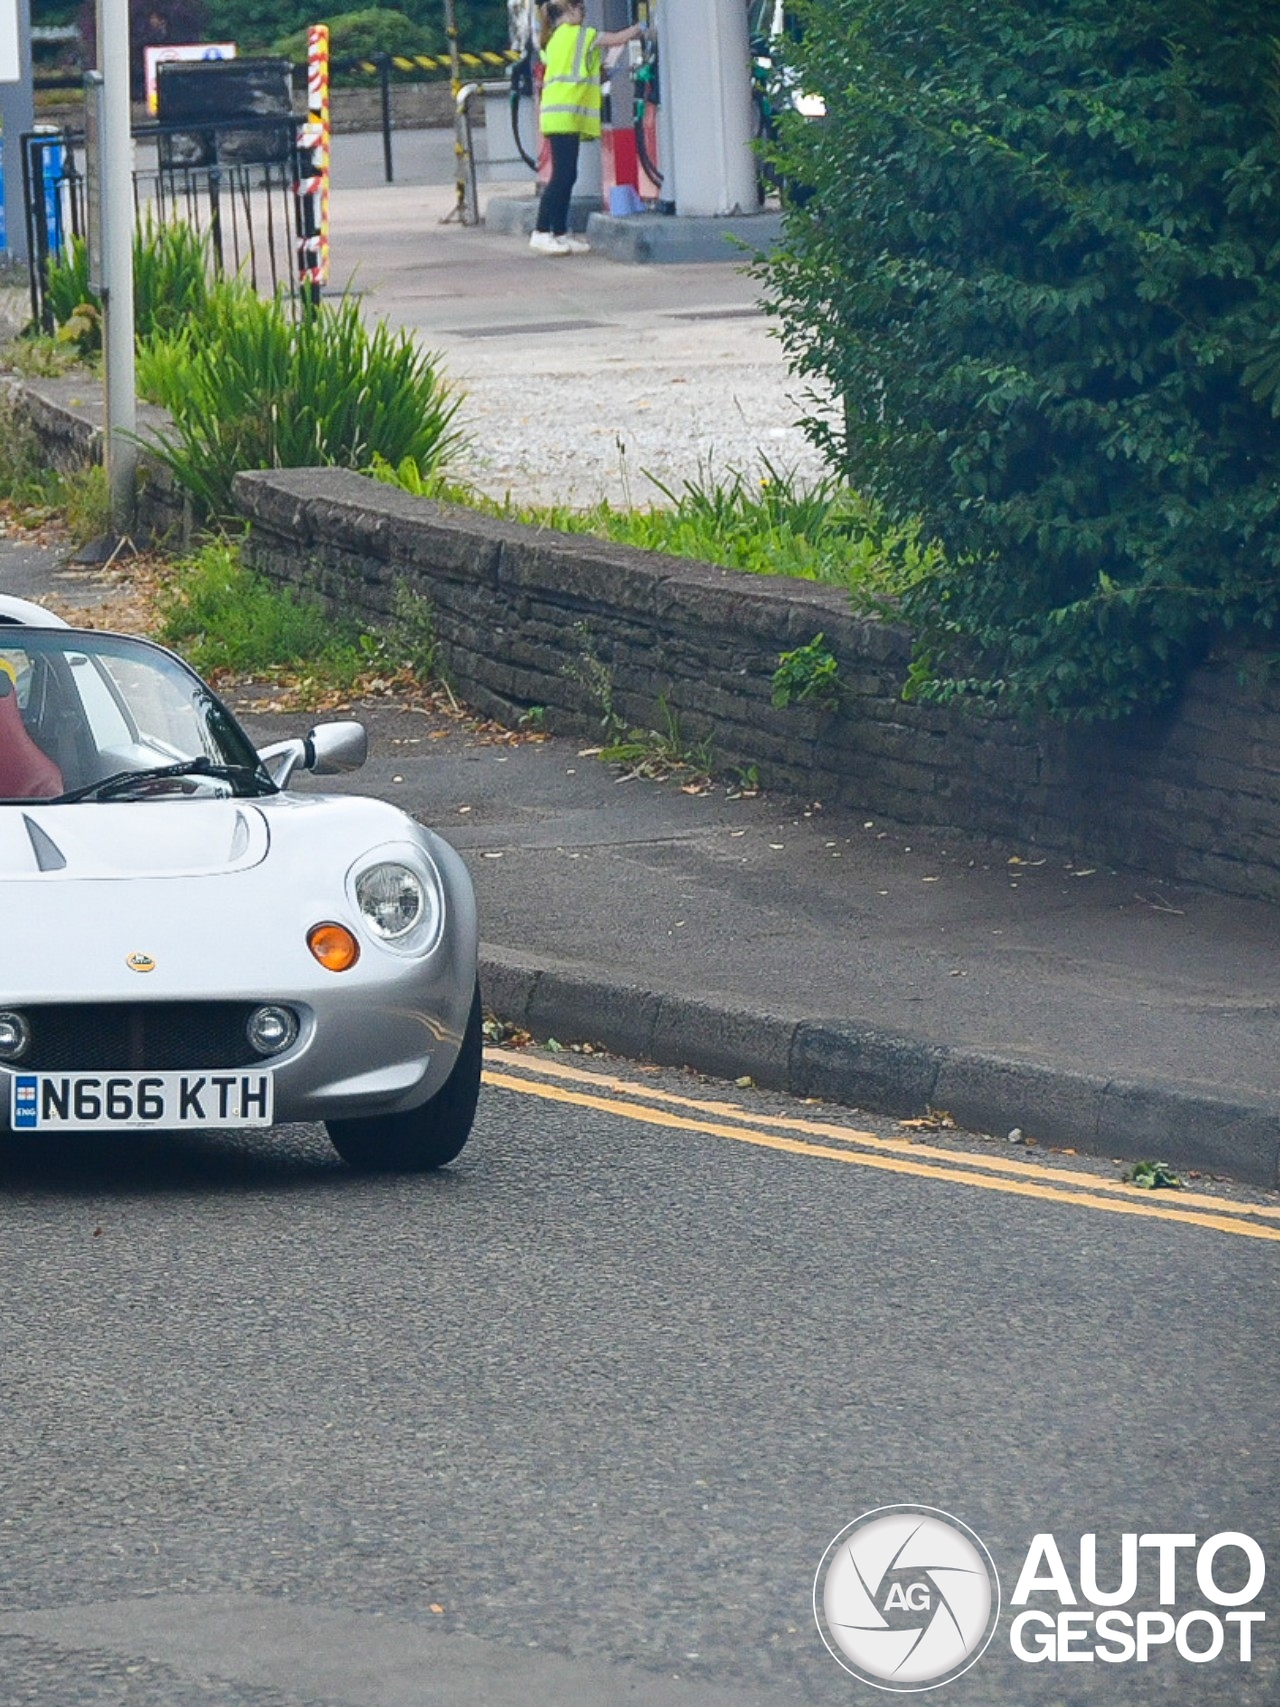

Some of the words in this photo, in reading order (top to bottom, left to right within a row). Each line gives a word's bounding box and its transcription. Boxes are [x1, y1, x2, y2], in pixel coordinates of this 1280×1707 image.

[42, 1077, 165, 1120] N666
[180, 1076, 267, 1119] KTH
[16, 1107, 36, 1117] ENG
